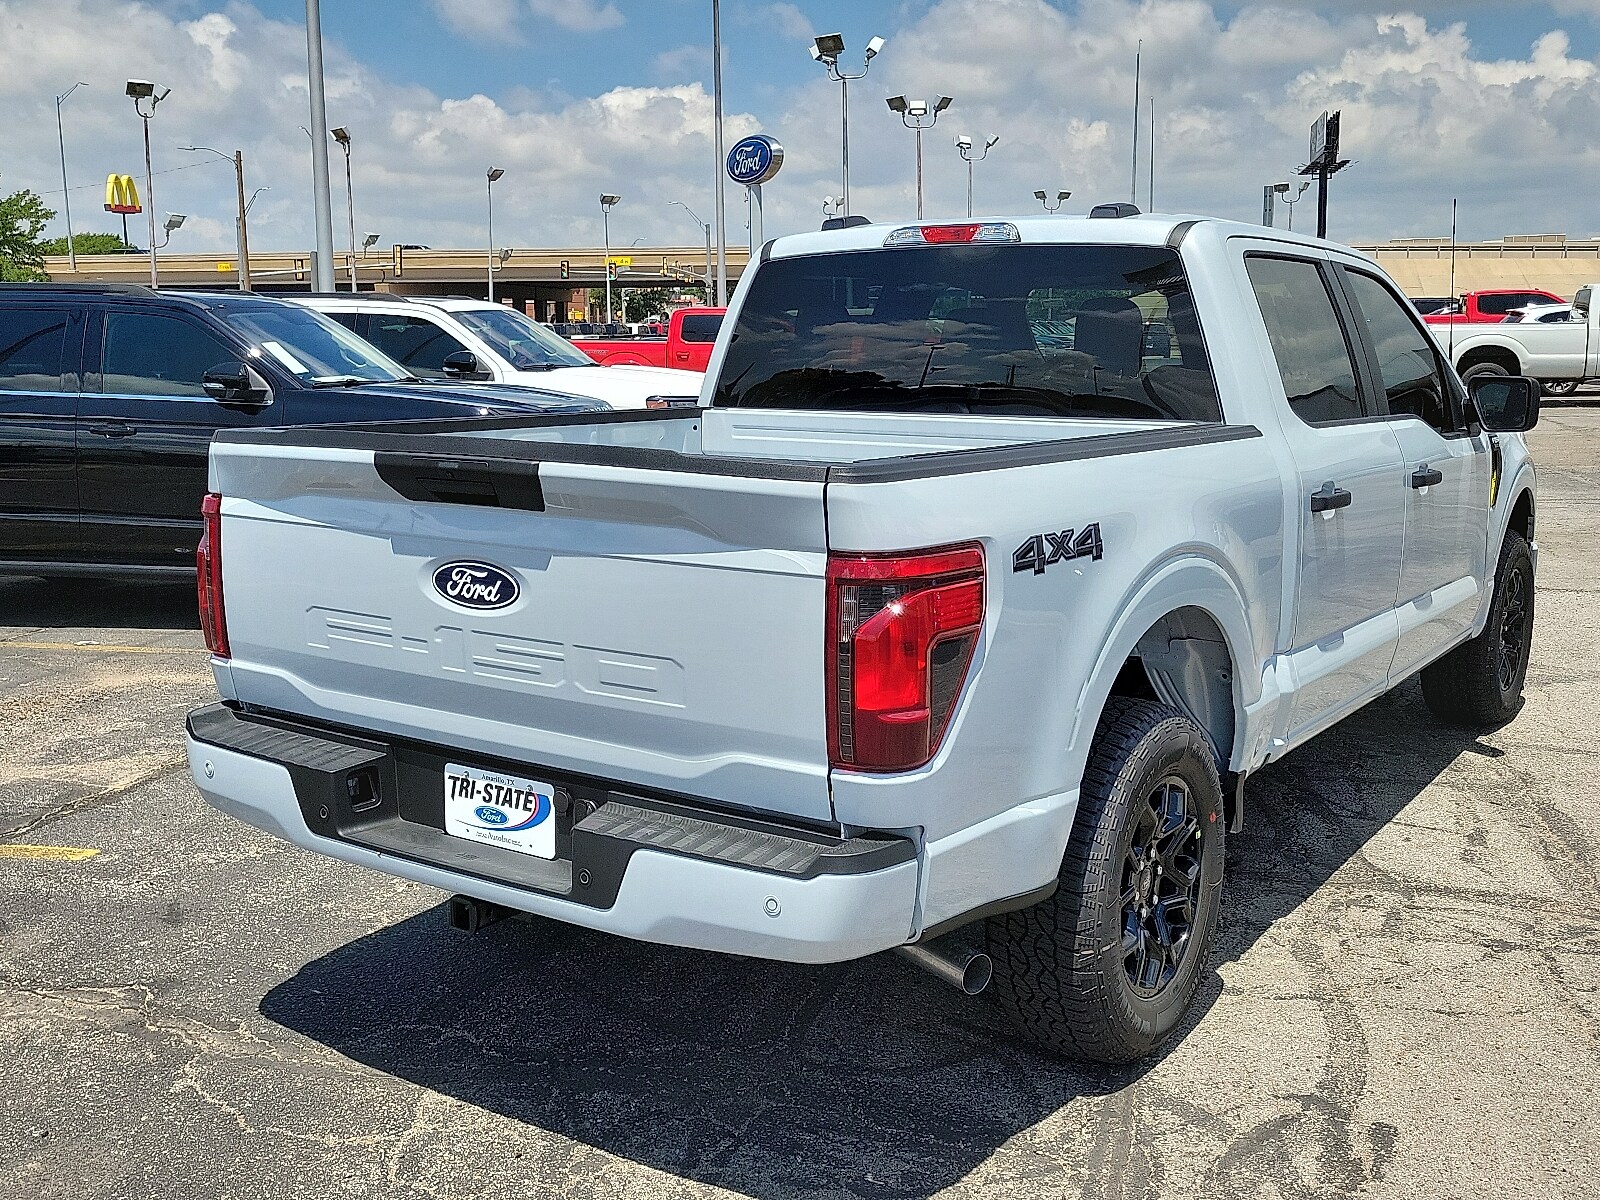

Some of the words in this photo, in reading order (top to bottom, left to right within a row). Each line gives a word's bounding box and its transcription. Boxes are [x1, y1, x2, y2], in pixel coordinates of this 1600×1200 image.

[734, 145, 761, 175] Ford
[446, 567, 502, 602] Ford
[305, 604, 687, 710] F-150
[447, 775, 534, 812] TRI-STATE
[480, 809, 502, 822] Ford
